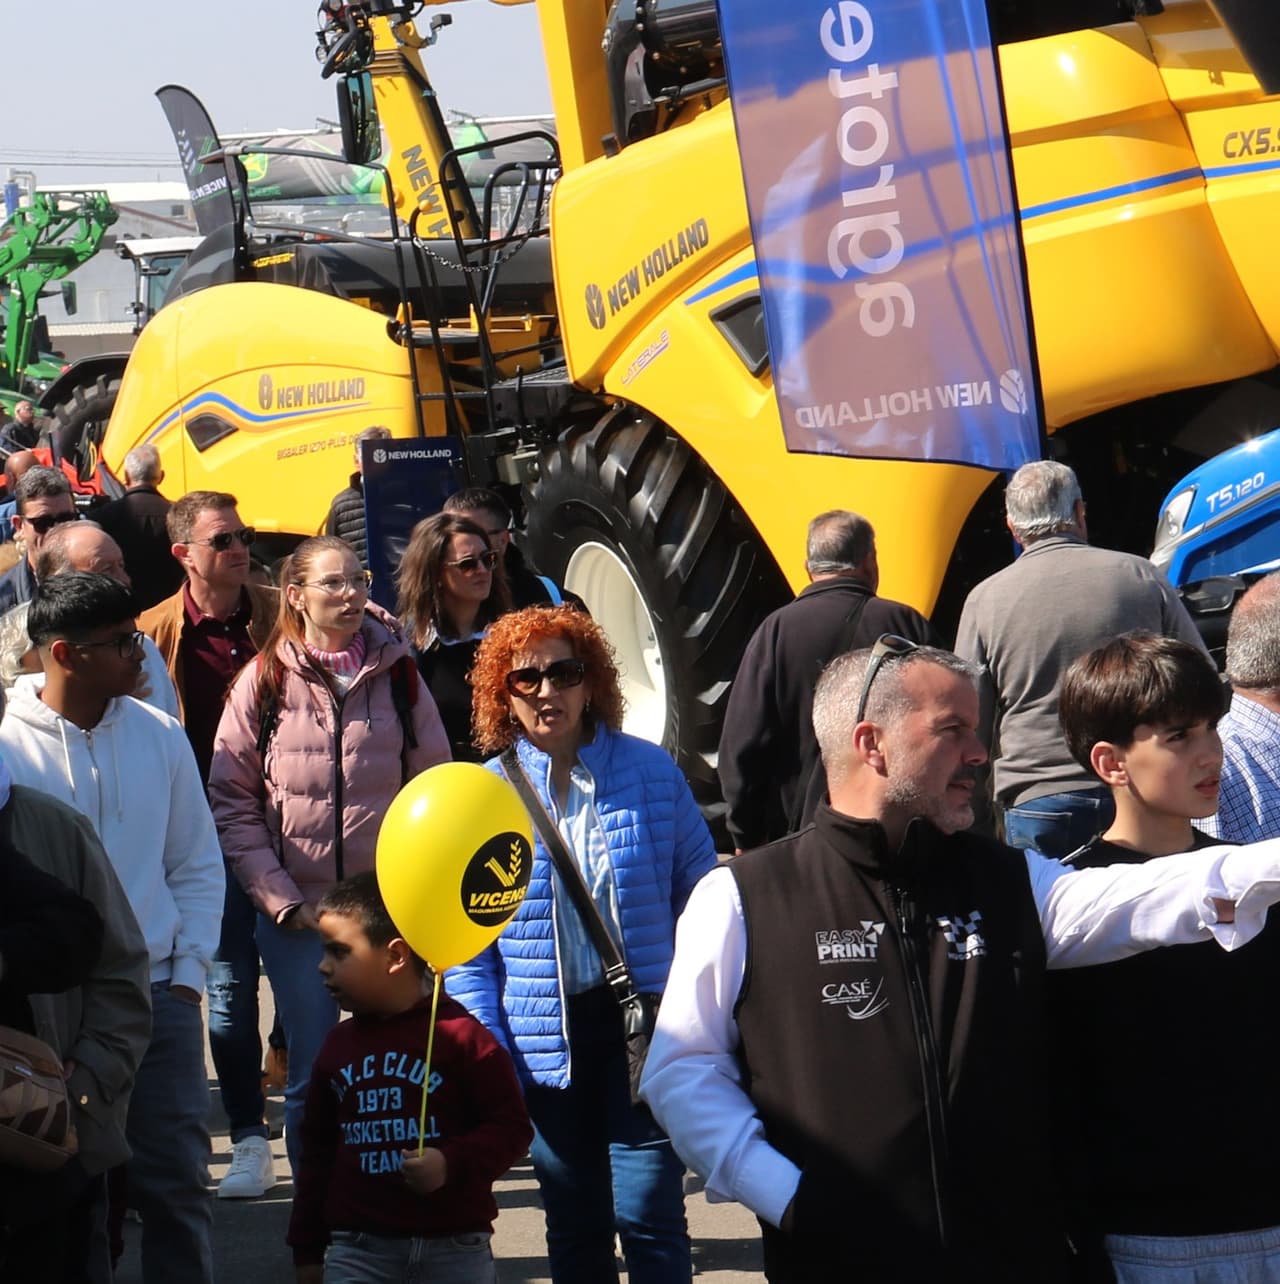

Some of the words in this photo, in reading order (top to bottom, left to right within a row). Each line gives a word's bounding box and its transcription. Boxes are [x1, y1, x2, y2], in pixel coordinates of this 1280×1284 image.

[401, 144, 443, 215] NEW
[607, 266, 640, 316] NEW
[641, 218, 709, 287] HOLLAND
[277, 385, 304, 409] NEW
[307, 377, 365, 405] HOLLAND
[388, 451, 408, 460] NEW
[410, 449, 452, 458] HOLLAND
[1206, 472, 1265, 512] T5.120
[470, 885, 527, 907] VICENS
[815, 929, 867, 946] EASY
[817, 943, 878, 960] PRINT
[357, 1086, 403, 1114] 1973
